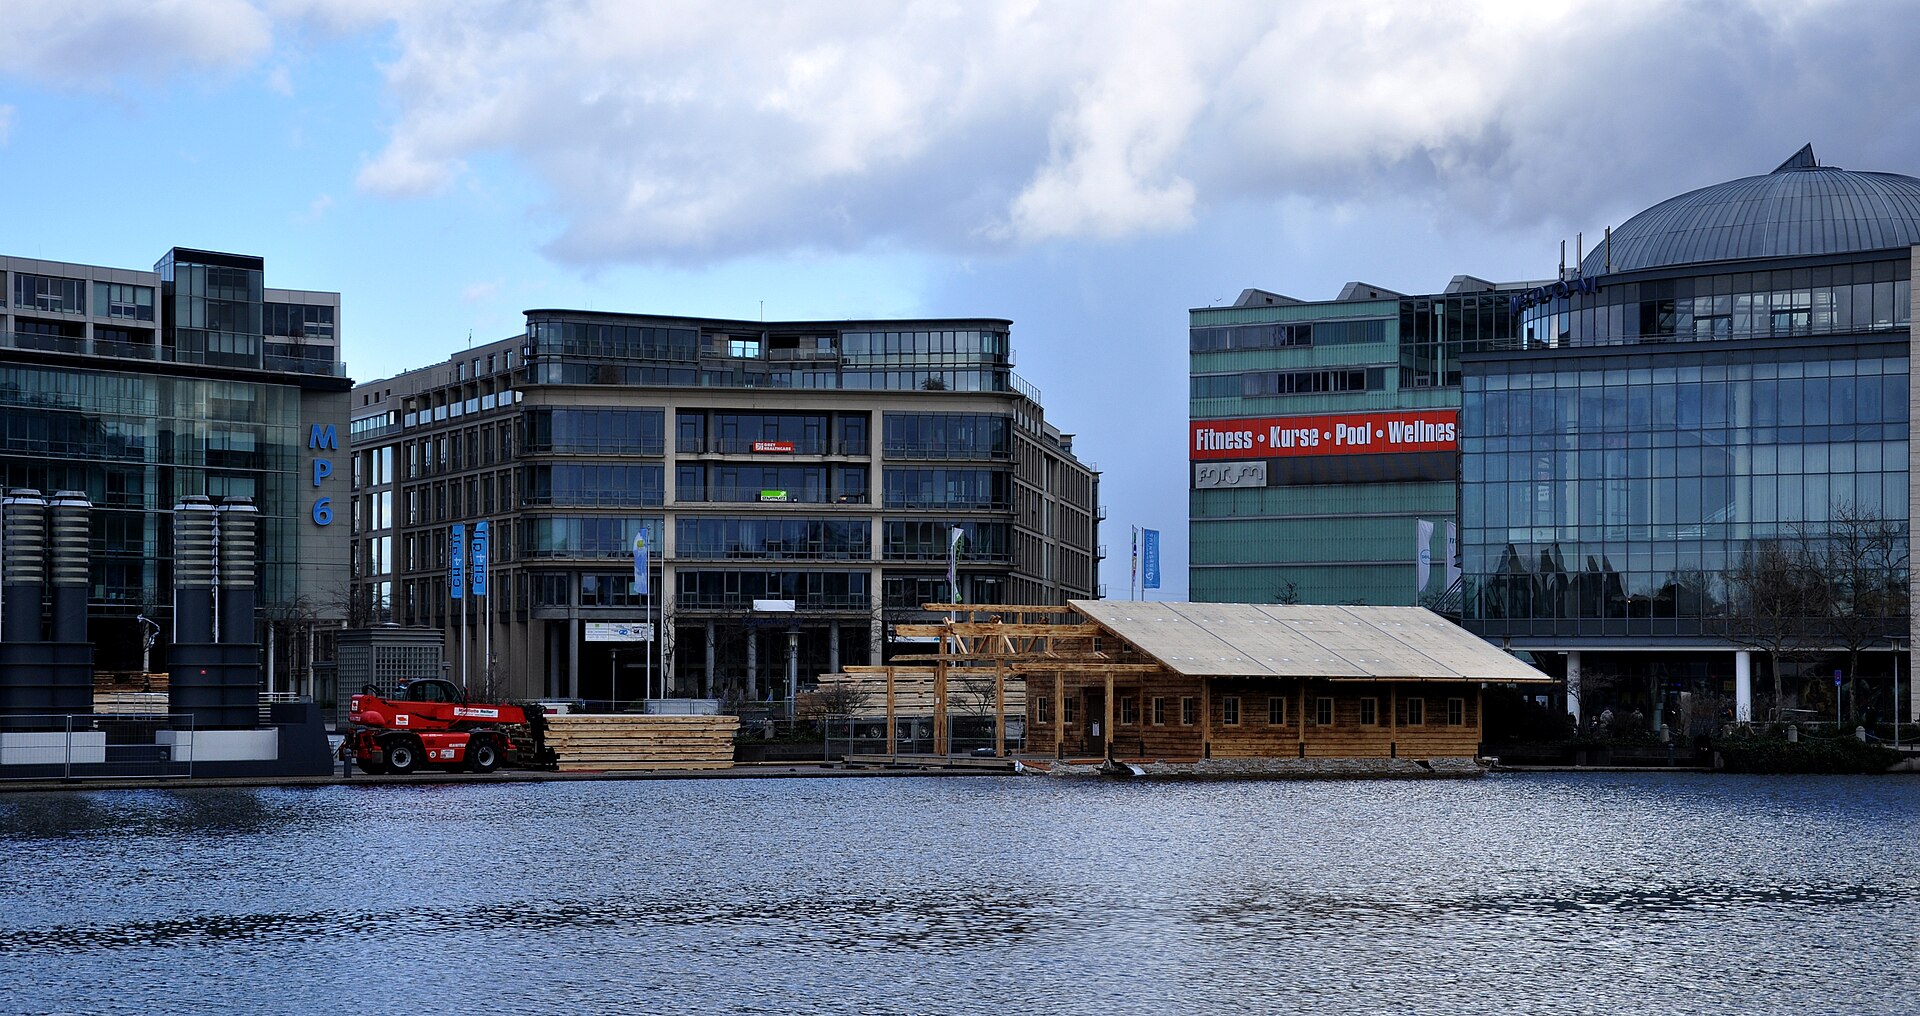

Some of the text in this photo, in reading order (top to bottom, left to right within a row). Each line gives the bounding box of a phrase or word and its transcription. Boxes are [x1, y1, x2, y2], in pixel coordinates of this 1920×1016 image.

[1196, 420, 1456, 450] Fitness Kurse Pool Wellnes
